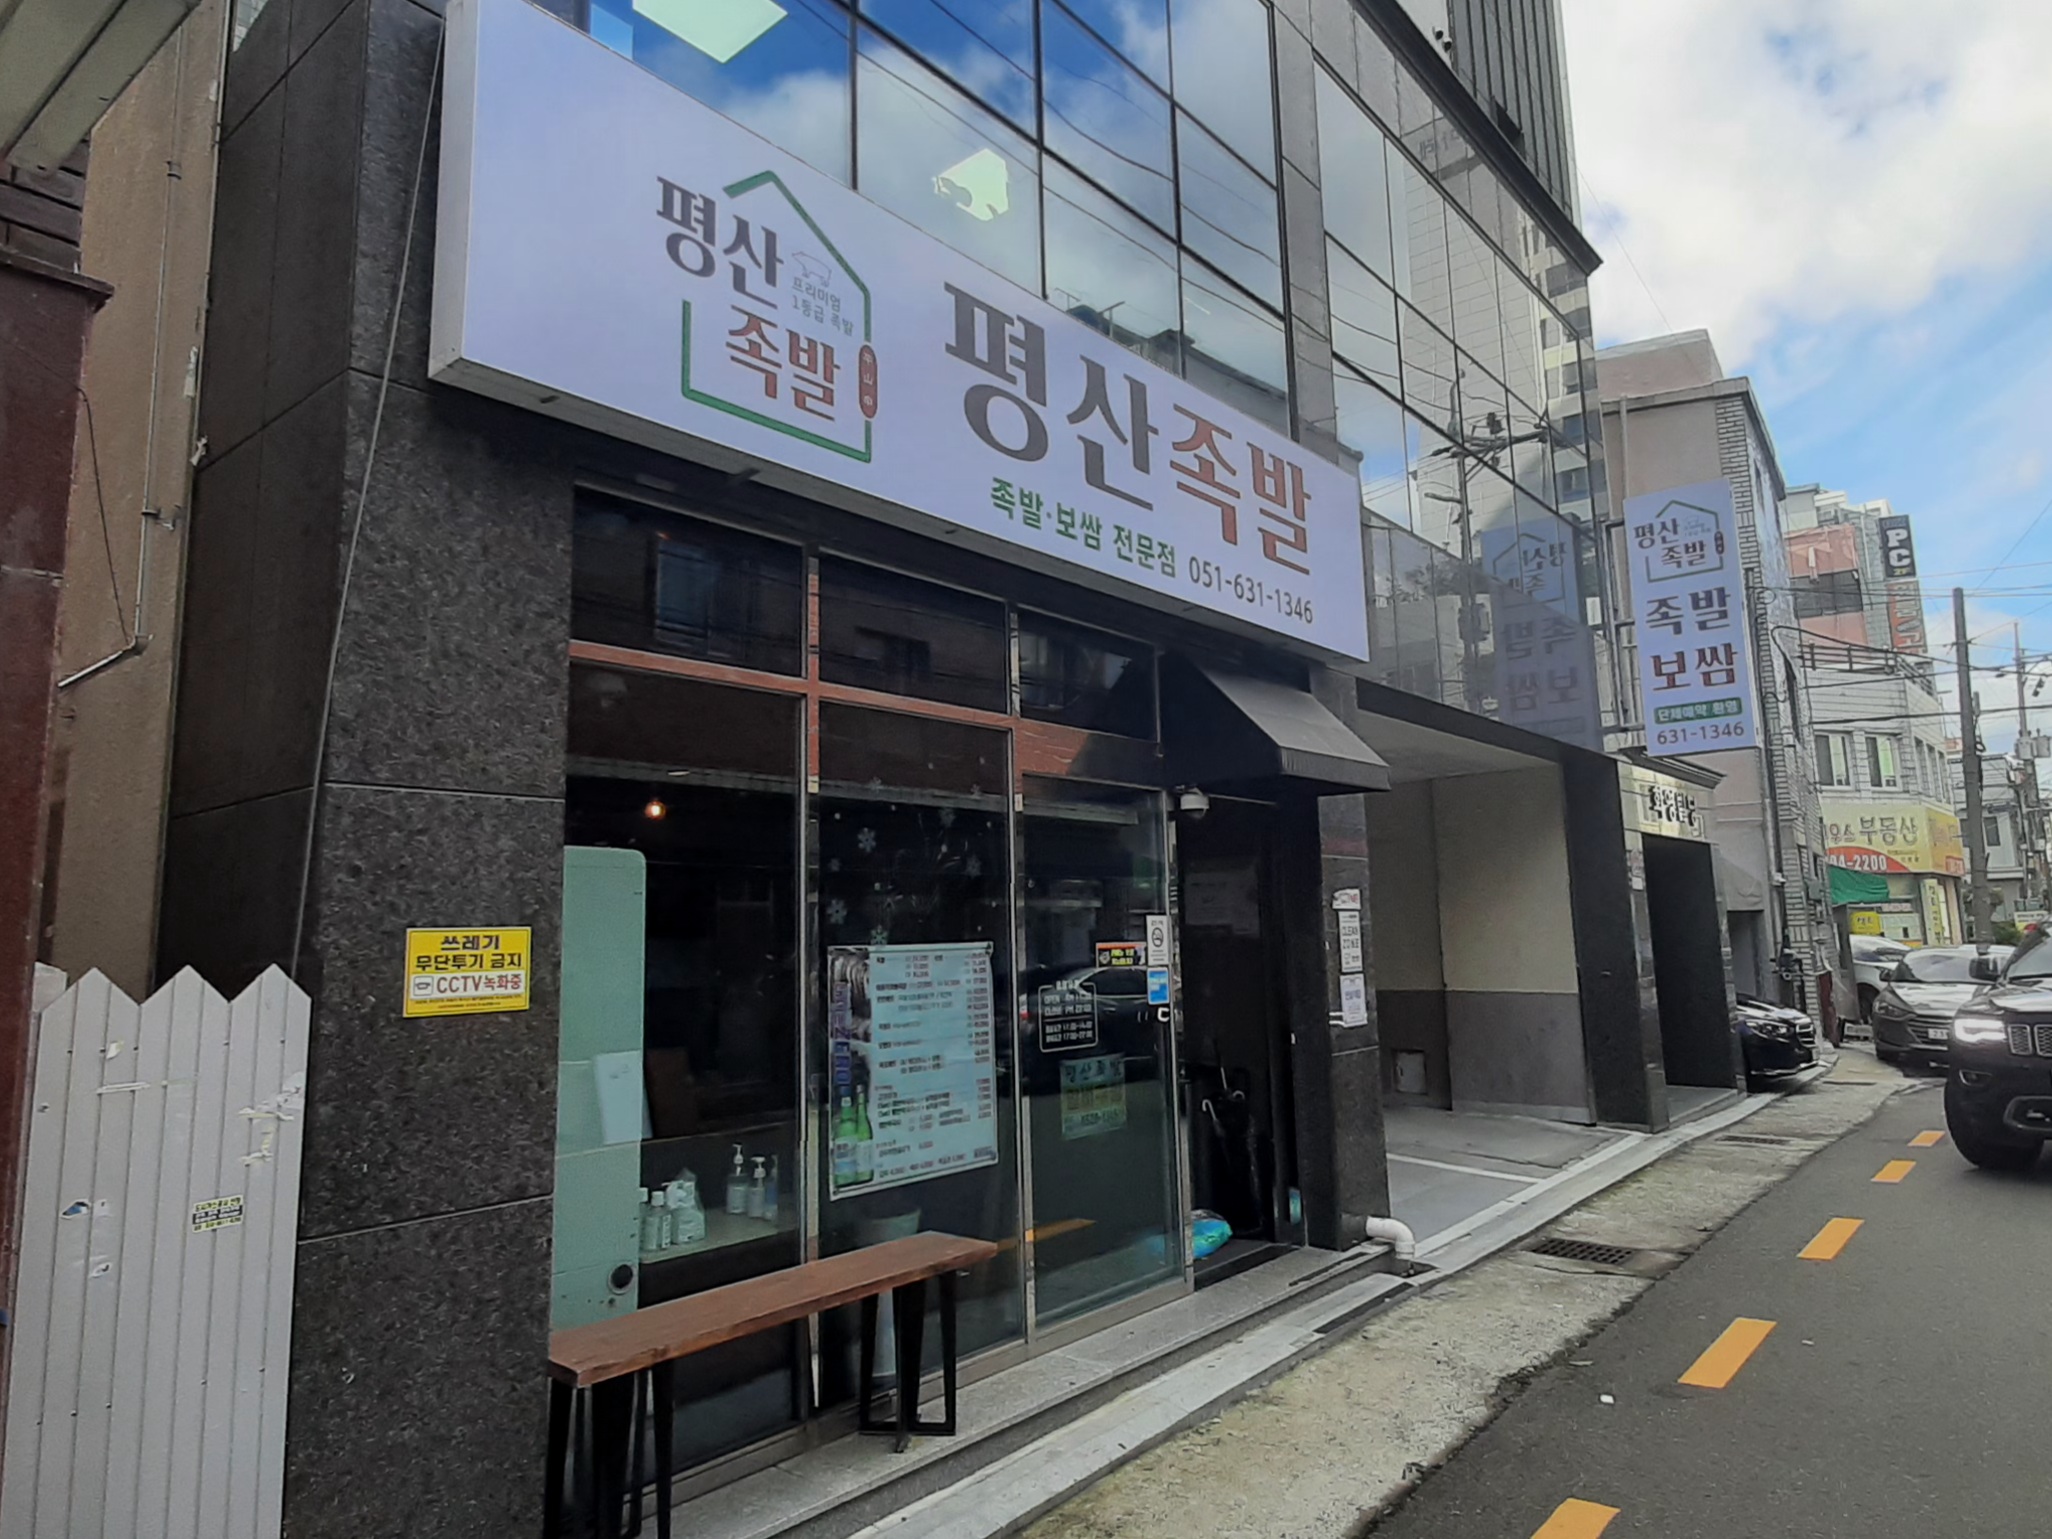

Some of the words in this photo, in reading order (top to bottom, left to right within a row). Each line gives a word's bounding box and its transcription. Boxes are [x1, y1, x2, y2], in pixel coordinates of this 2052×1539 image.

[656, 175, 784, 310] 평산
[792, 276, 841, 313] 프리미엄
[792, 294, 825, 324] 1등급
[830, 312, 854, 337] 족발
[725, 304, 841, 422] 족발
[1633, 517, 1680, 550] 평산
[1886, 528, 1911, 568] PC
[1661, 540, 1706, 569] 족발
[1112, 523, 1176, 579] 전문점
[1188, 555, 1314, 625] 051-631-1346
[1645, 586, 1731, 636] 족발
[1650, 642, 1738, 692] 보쌈
[1657, 704, 1707, 722] 단체예약
[1711, 700, 1739, 716] 환영
[1656, 721, 1745, 745] 631-1346
[1859, 816, 1917, 846] 부동산
[440, 934, 500, 951] 쓰레기
[416, 953, 484, 971] 무단투기
[490, 952, 522, 969] 금지
